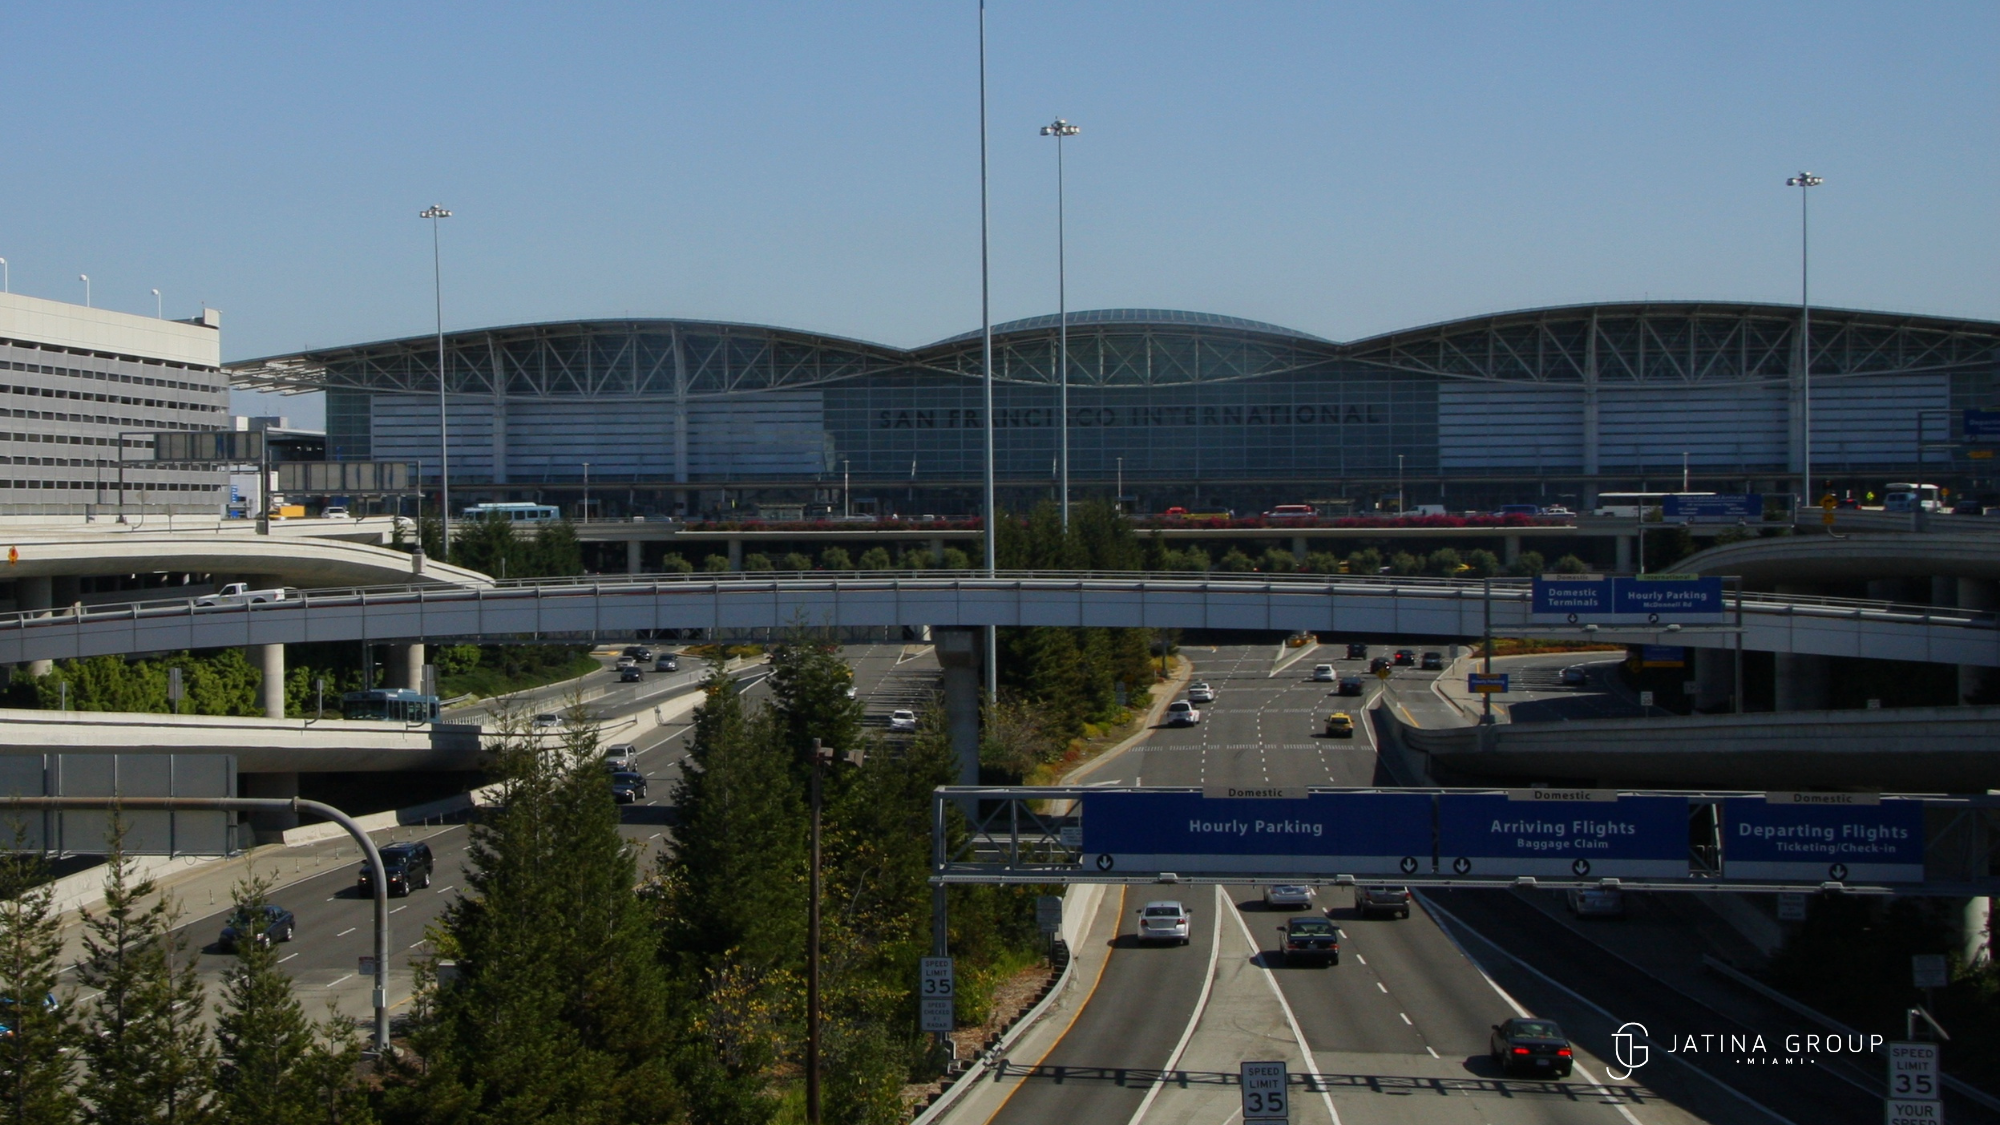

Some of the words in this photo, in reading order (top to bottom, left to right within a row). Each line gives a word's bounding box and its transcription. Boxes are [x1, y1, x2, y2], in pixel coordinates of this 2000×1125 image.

[879, 409, 935, 428] SAN
[1133, 404, 1380, 426] INTERNATIONAL
[1548, 588, 1597, 597] Domestic
[1627, 591, 1663, 601] Hourly
[1666, 591, 1708, 602] Parking
[1548, 598, 1599, 607] Terminals
[1228, 788, 1283, 798] Domestic
[1534, 790, 1592, 801] Domestic
[1793, 793, 1853, 804] Domestic
[1189, 819, 1248, 837] Hourly
[1255, 820, 1323, 837] Parking
[1491, 819, 1565, 837] Arriving
[1573, 820, 1636, 838] Flights
[1739, 822, 1835, 842] Departing
[1843, 824, 1908, 842] Flights
[1517, 838, 1570, 851] Baggage
[1573, 838, 1609, 849] Claim
[1776, 841, 1897, 854] Ticketing/Check-in
[926, 969, 947, 977] LIMIT
[924, 979, 951, 994] 35
[1892, 1048, 1934, 1058] SPEED
[1248, 1067, 1280, 1076] SPEED
[1896, 1061, 1929, 1071] LIMIT
[1249, 1080, 1279, 1089] LIMIT
[1895, 1074, 1932, 1094] 35
[1248, 1092, 1284, 1112] 35
[1895, 1104, 1933, 1117] YOUR
